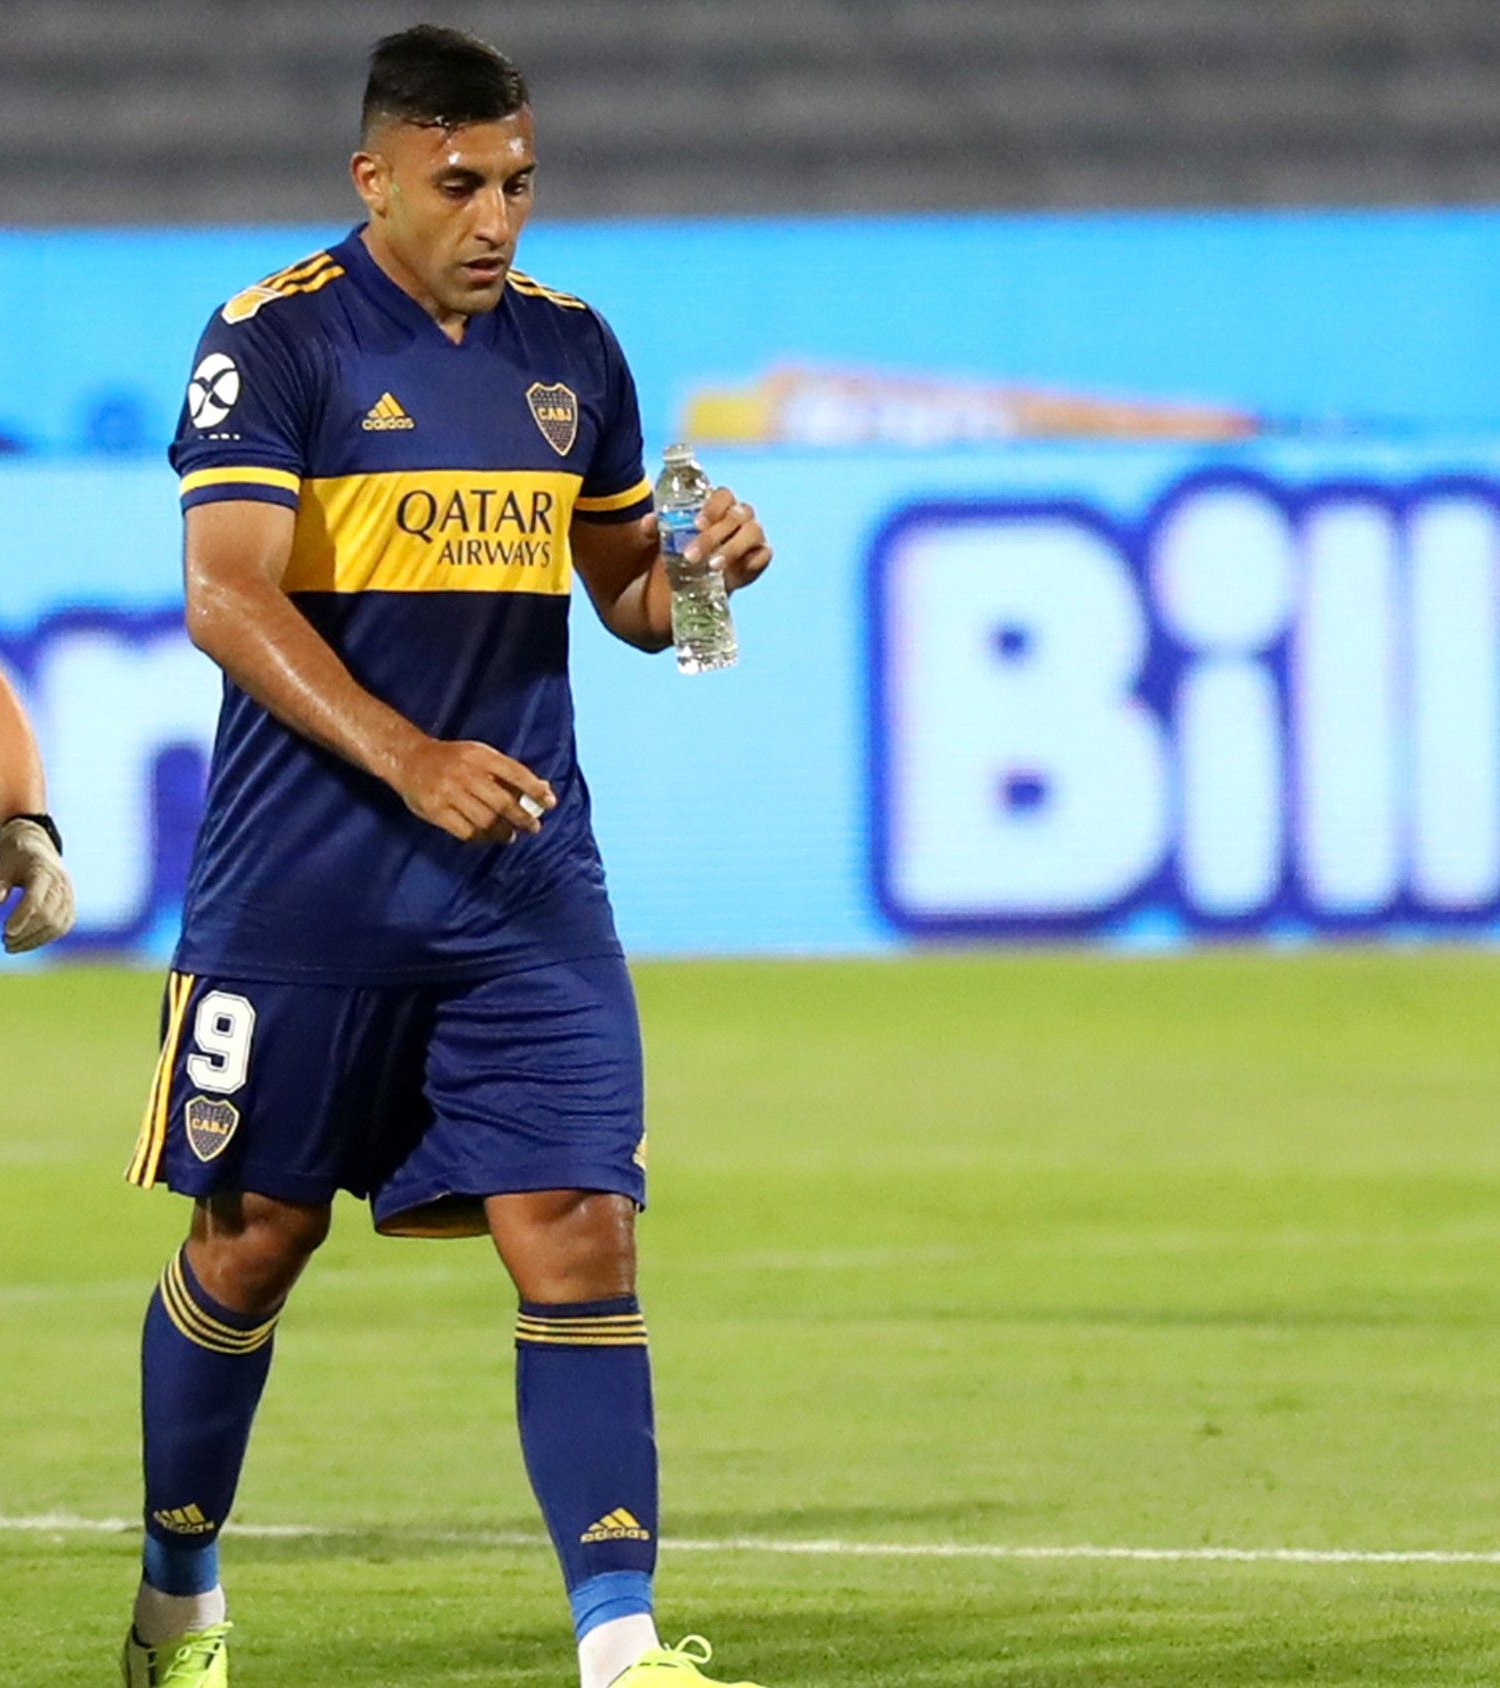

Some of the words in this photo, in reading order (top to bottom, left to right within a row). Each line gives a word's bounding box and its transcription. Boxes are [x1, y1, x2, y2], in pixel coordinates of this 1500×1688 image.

[362, 416, 415, 431] adidas
[395, 489, 553, 544] QATAR
[437, 539, 551, 569] AIRWAYS
[186, 989, 257, 1095] 9
[580, 1525, 650, 1543] adidas
